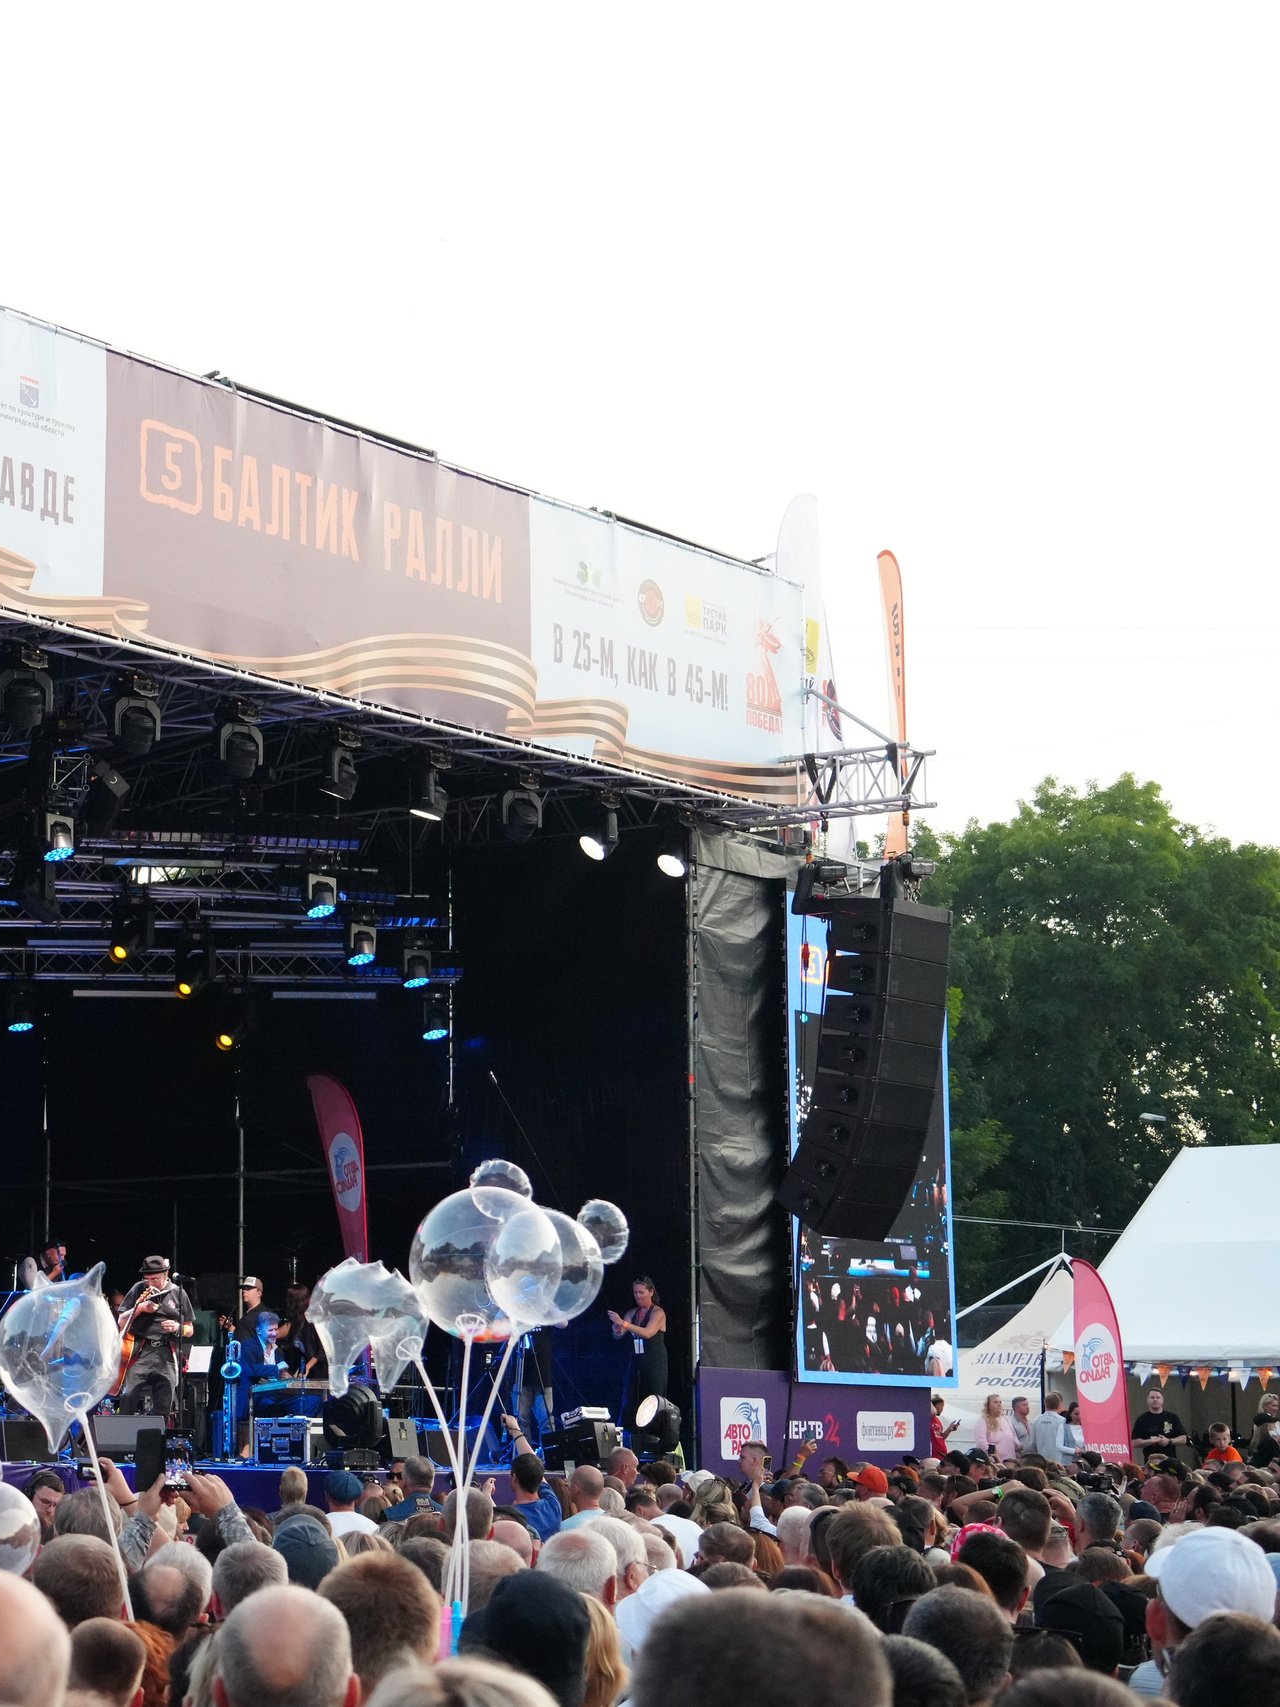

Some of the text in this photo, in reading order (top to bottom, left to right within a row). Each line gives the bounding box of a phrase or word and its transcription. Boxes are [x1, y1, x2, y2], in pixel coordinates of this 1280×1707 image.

[8, 405, 16, 413] по
[17, 408, 45, 422] культуре
[40, 424, 65, 437] области
[213, 445, 360, 562] БАЛТИК
[383, 500, 503, 604] РАЛЛИ
[703, 606, 727, 622] ТРЕТИЙ
[703, 617, 727, 637] ПАРК
[553, 622, 564, 664] В
[572, 629, 619, 689] 25-М,
[627, 645, 659, 692] КАК
[667, 657, 677, 697] В
[746, 672, 766, 706] 80
[746, 709, 783, 735] ПОБЕДА!
[724, 1424, 751, 1440] АВТО
[894, 1421, 907, 1439] 25
